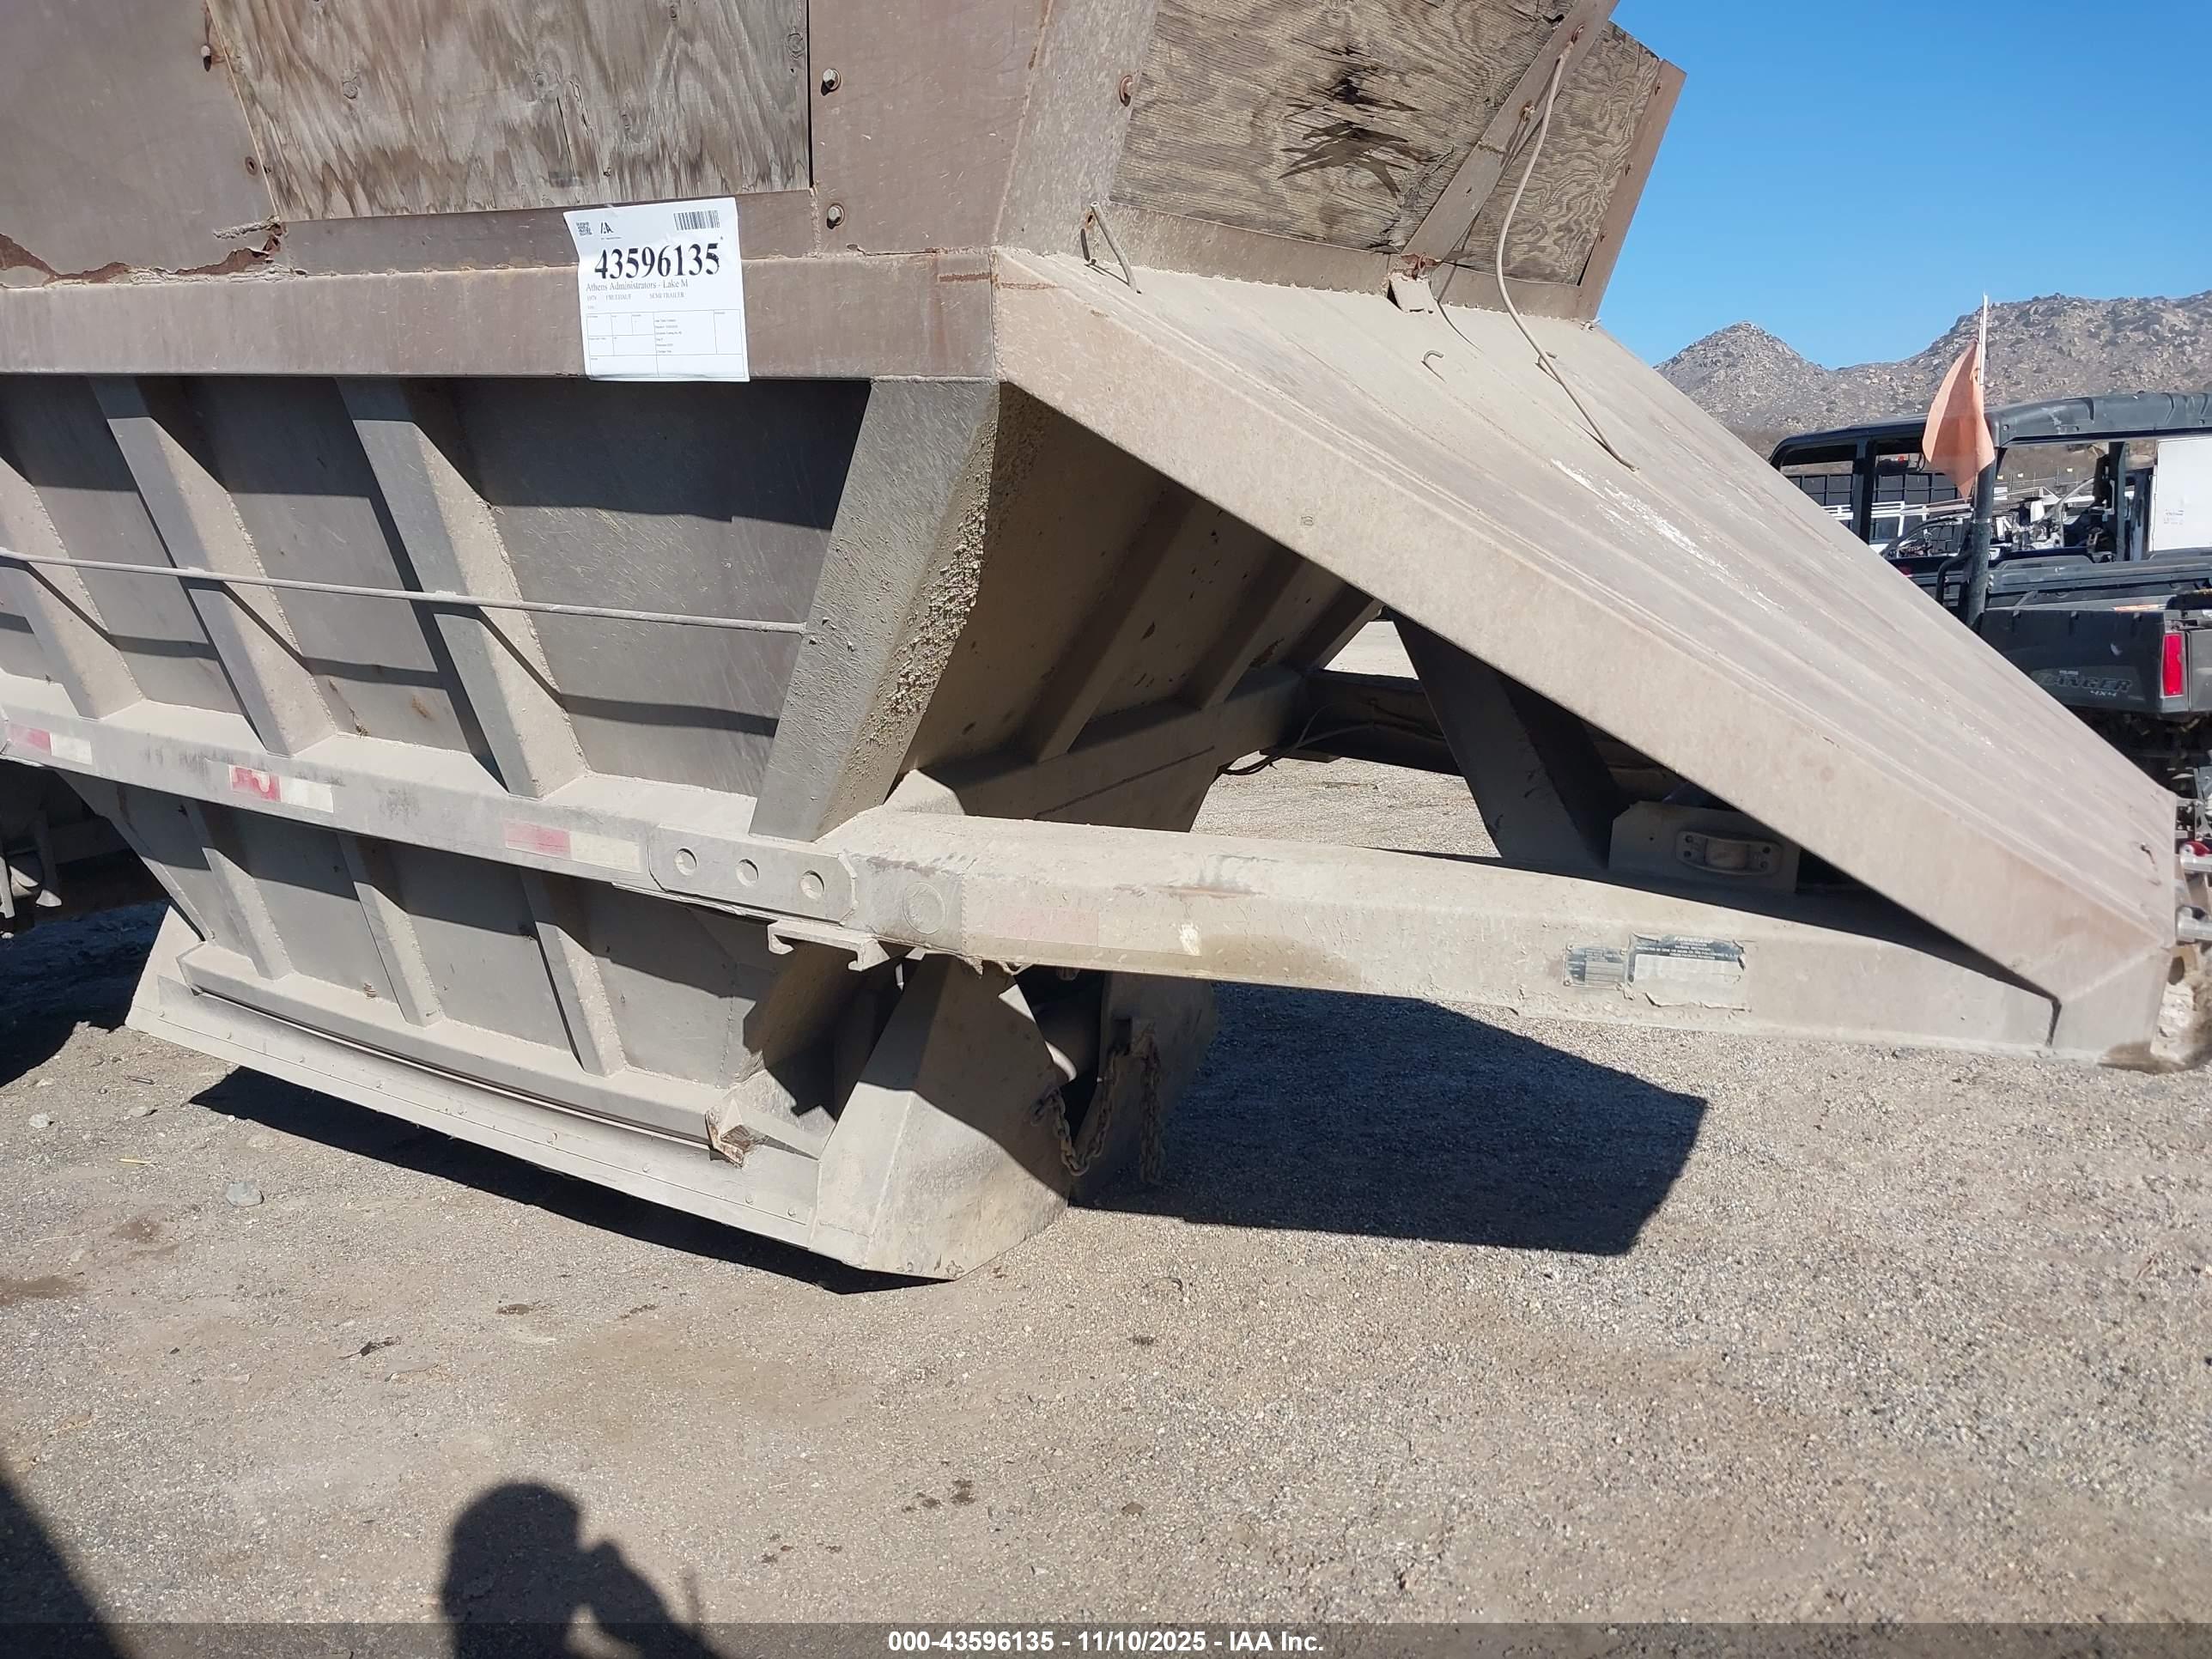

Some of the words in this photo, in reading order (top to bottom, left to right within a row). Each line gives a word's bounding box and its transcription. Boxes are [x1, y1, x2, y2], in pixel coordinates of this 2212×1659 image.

[594, 243, 720, 279] 43596135
[586, 283, 607, 291] Athens
[609, 281, 656, 290] Administrators
[663, 278, 679, 289] Lake
[680, 278, 688, 288] M
